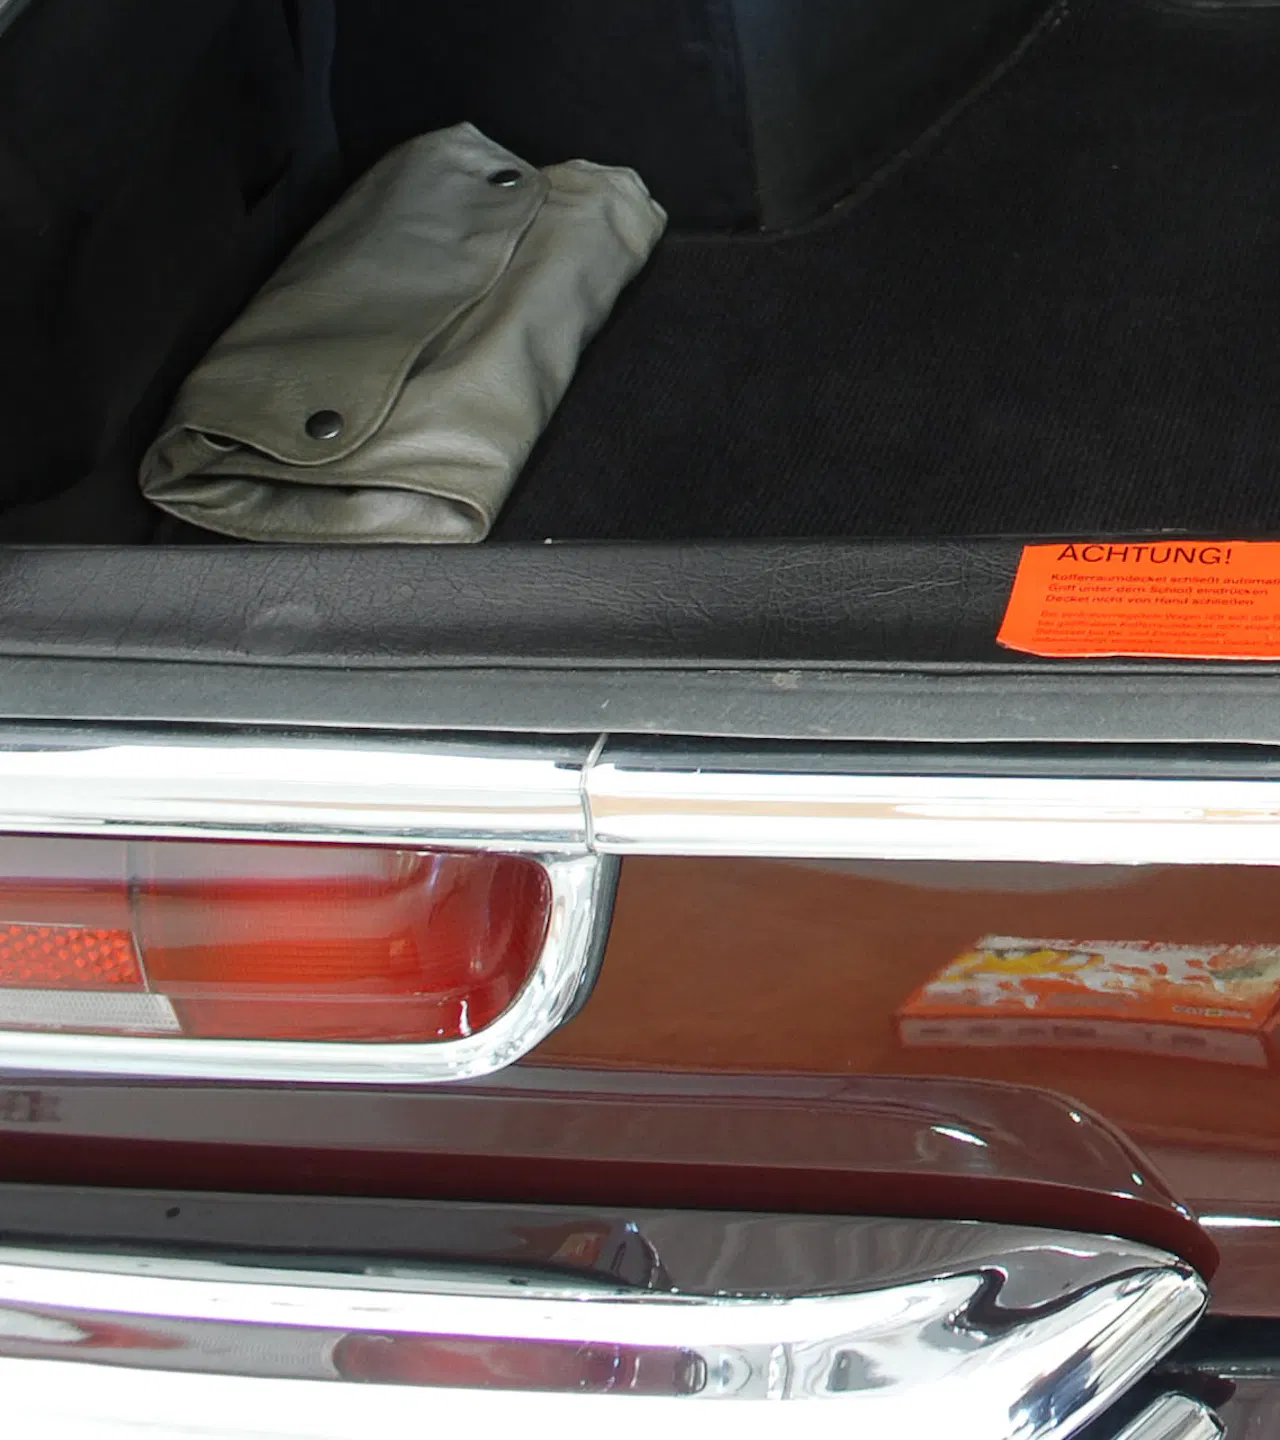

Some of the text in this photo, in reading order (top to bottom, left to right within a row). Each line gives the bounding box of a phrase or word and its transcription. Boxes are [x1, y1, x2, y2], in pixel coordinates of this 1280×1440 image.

[1056, 543, 1233, 565] ACHTUNG!
[1079, 585, 1113, 593] unter
[1115, 585, 1145, 593] dem
[1045, 594, 1090, 603] Deckel
[1092, 595, 1123, 604] nicht
[1127, 596, 1153, 604] von
[1155, 596, 1189, 605] Hand
